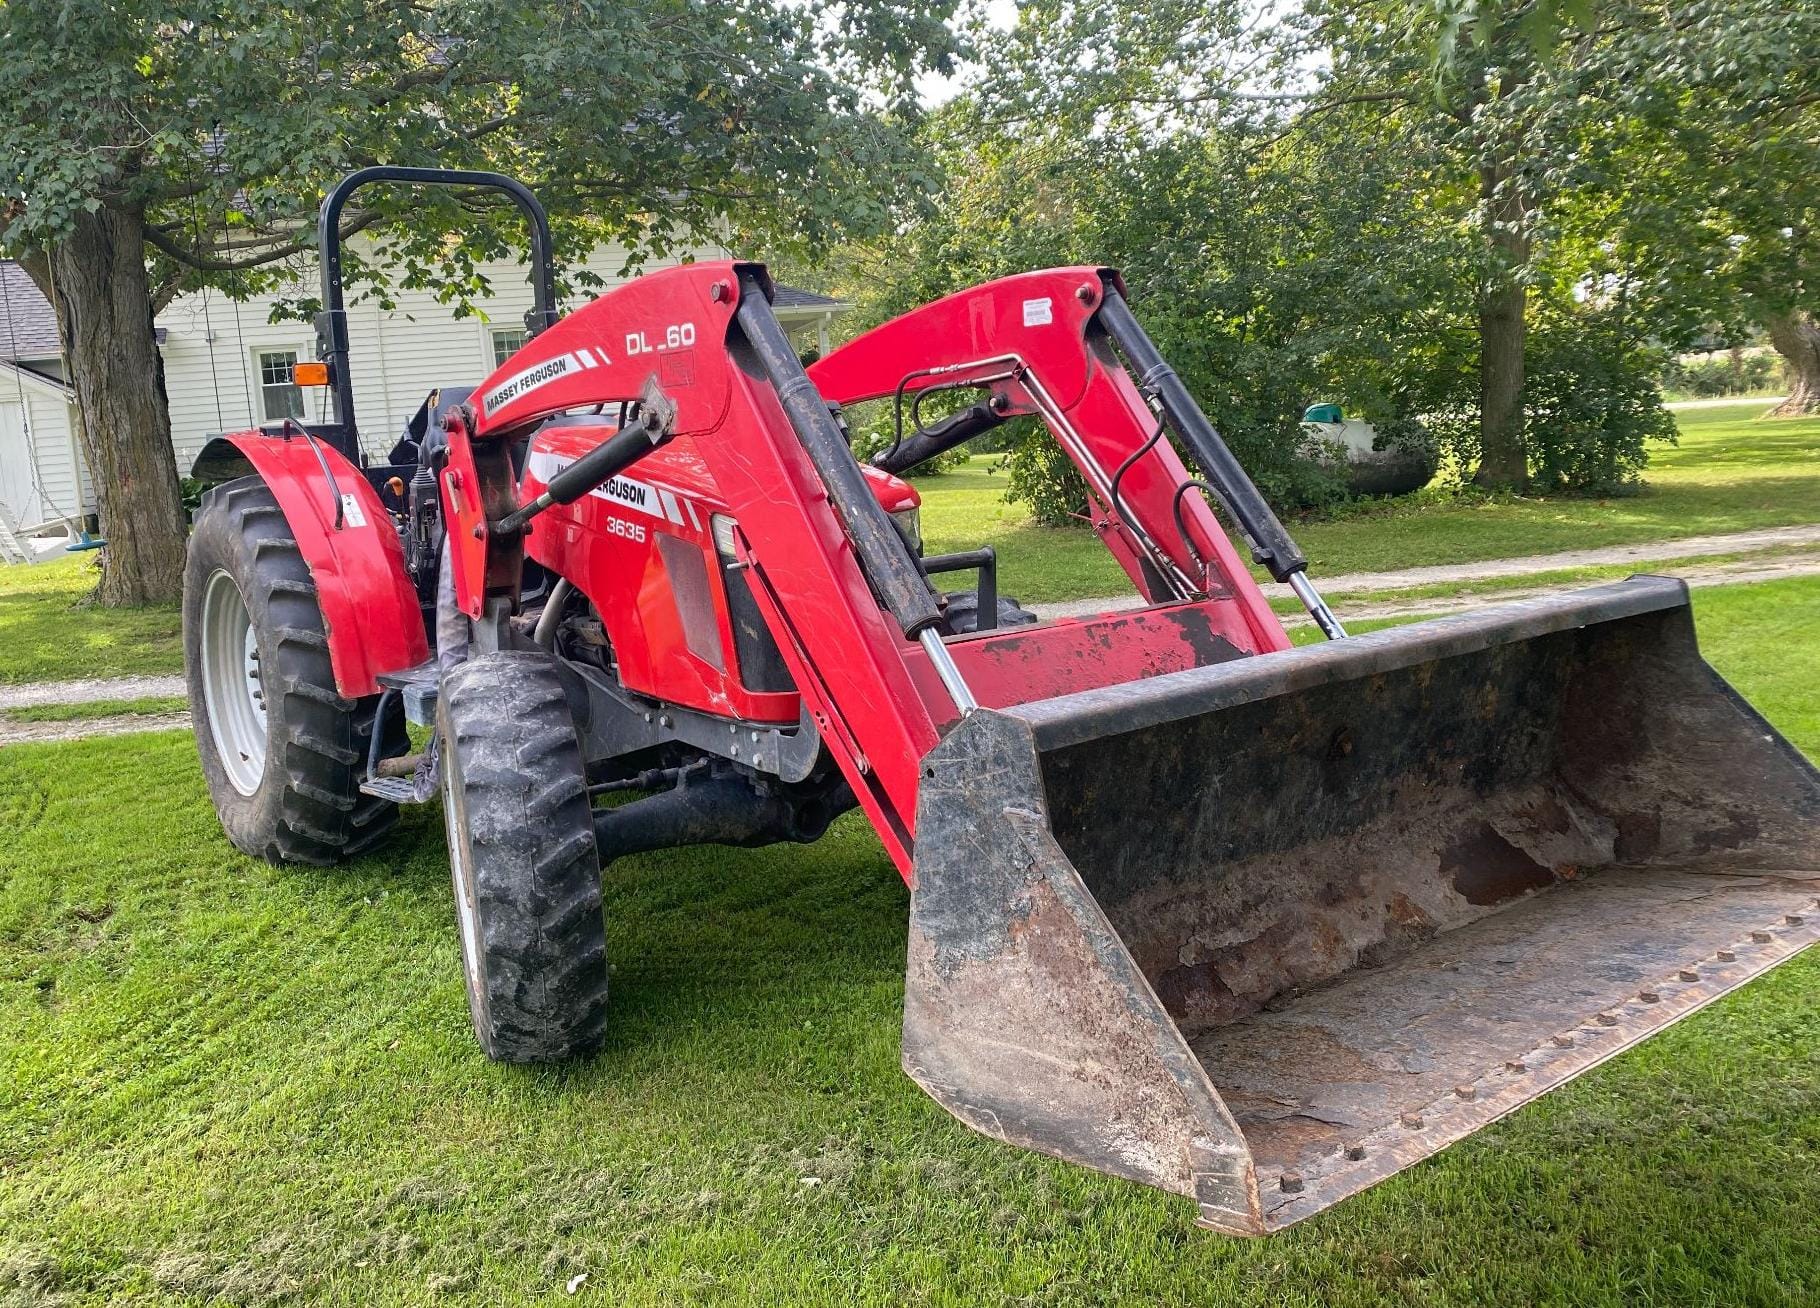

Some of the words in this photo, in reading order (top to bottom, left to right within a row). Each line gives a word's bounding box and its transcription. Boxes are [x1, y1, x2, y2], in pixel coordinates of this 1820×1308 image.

[486, 381, 518, 412] MASSEY
[520, 358, 567, 389] FERGUSON
[596, 479, 646, 506] RGUSON
[606, 515, 646, 543] 3635
